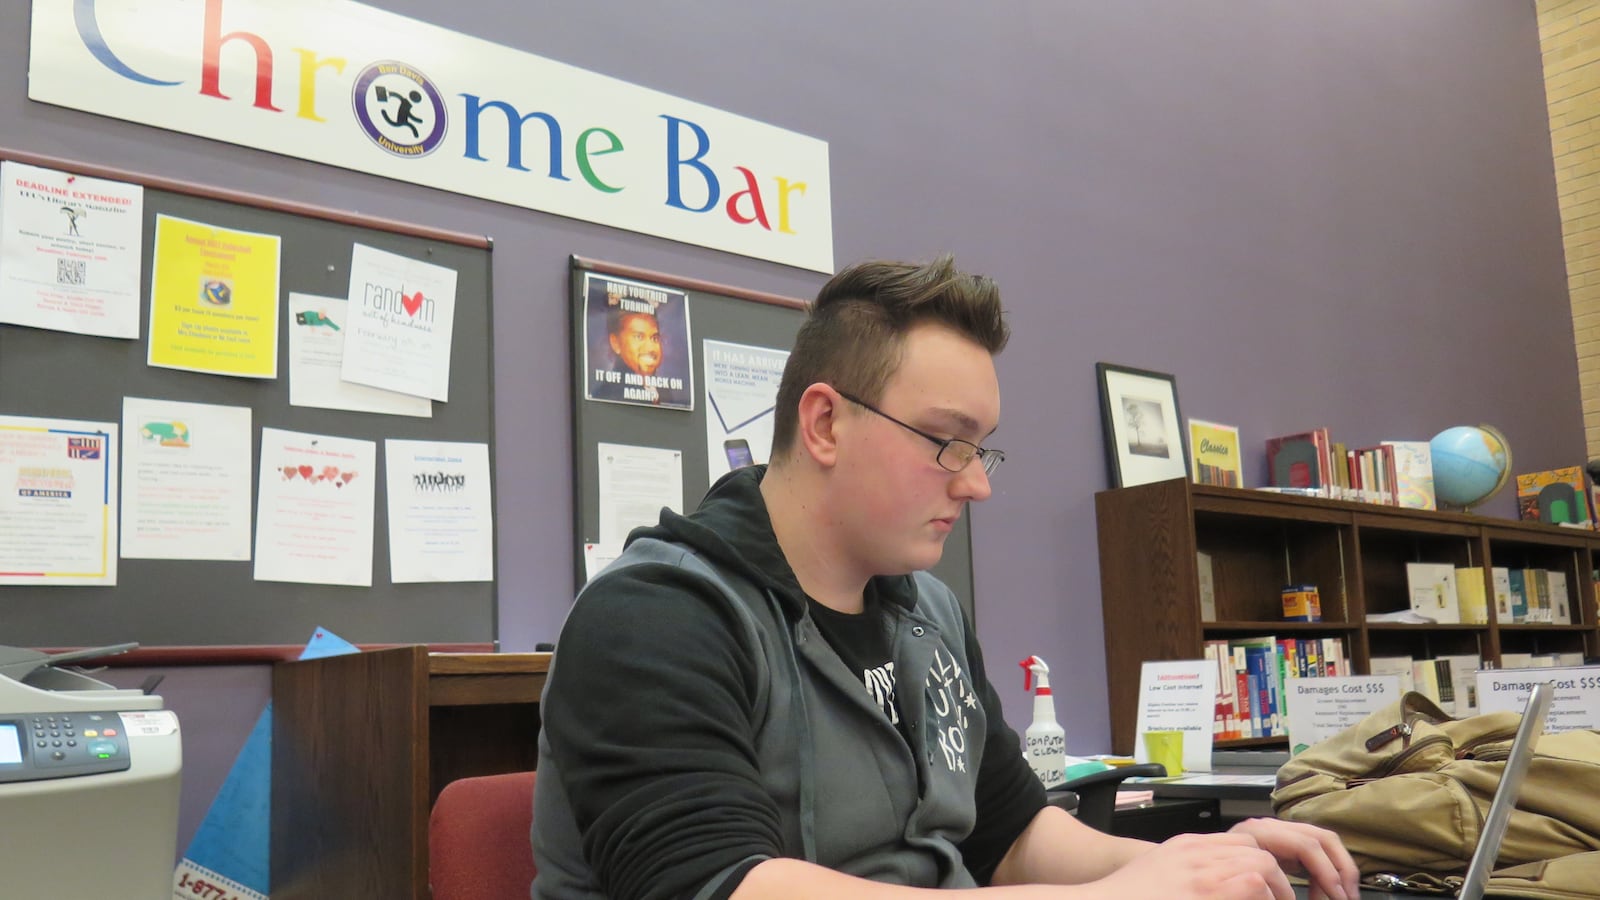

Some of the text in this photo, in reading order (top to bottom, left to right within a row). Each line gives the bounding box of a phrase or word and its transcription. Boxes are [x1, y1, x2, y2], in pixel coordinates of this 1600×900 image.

[378, 64, 425, 86] Ben Davis
[378, 136, 425, 155] University
[658, 114, 807, 235] Bar
[16, 178, 69, 197] DEADLINE
[72, 189, 132, 206] EXTENDED!
[607, 282, 668, 304] HAVE YOU TRIED
[620, 299, 655, 315] TURNING
[595, 369, 683, 390] IT OFF AND BACK ON
[623, 387, 659, 402] AGAIN?
[1297, 683, 1385, 696] Damages Cost $$$
